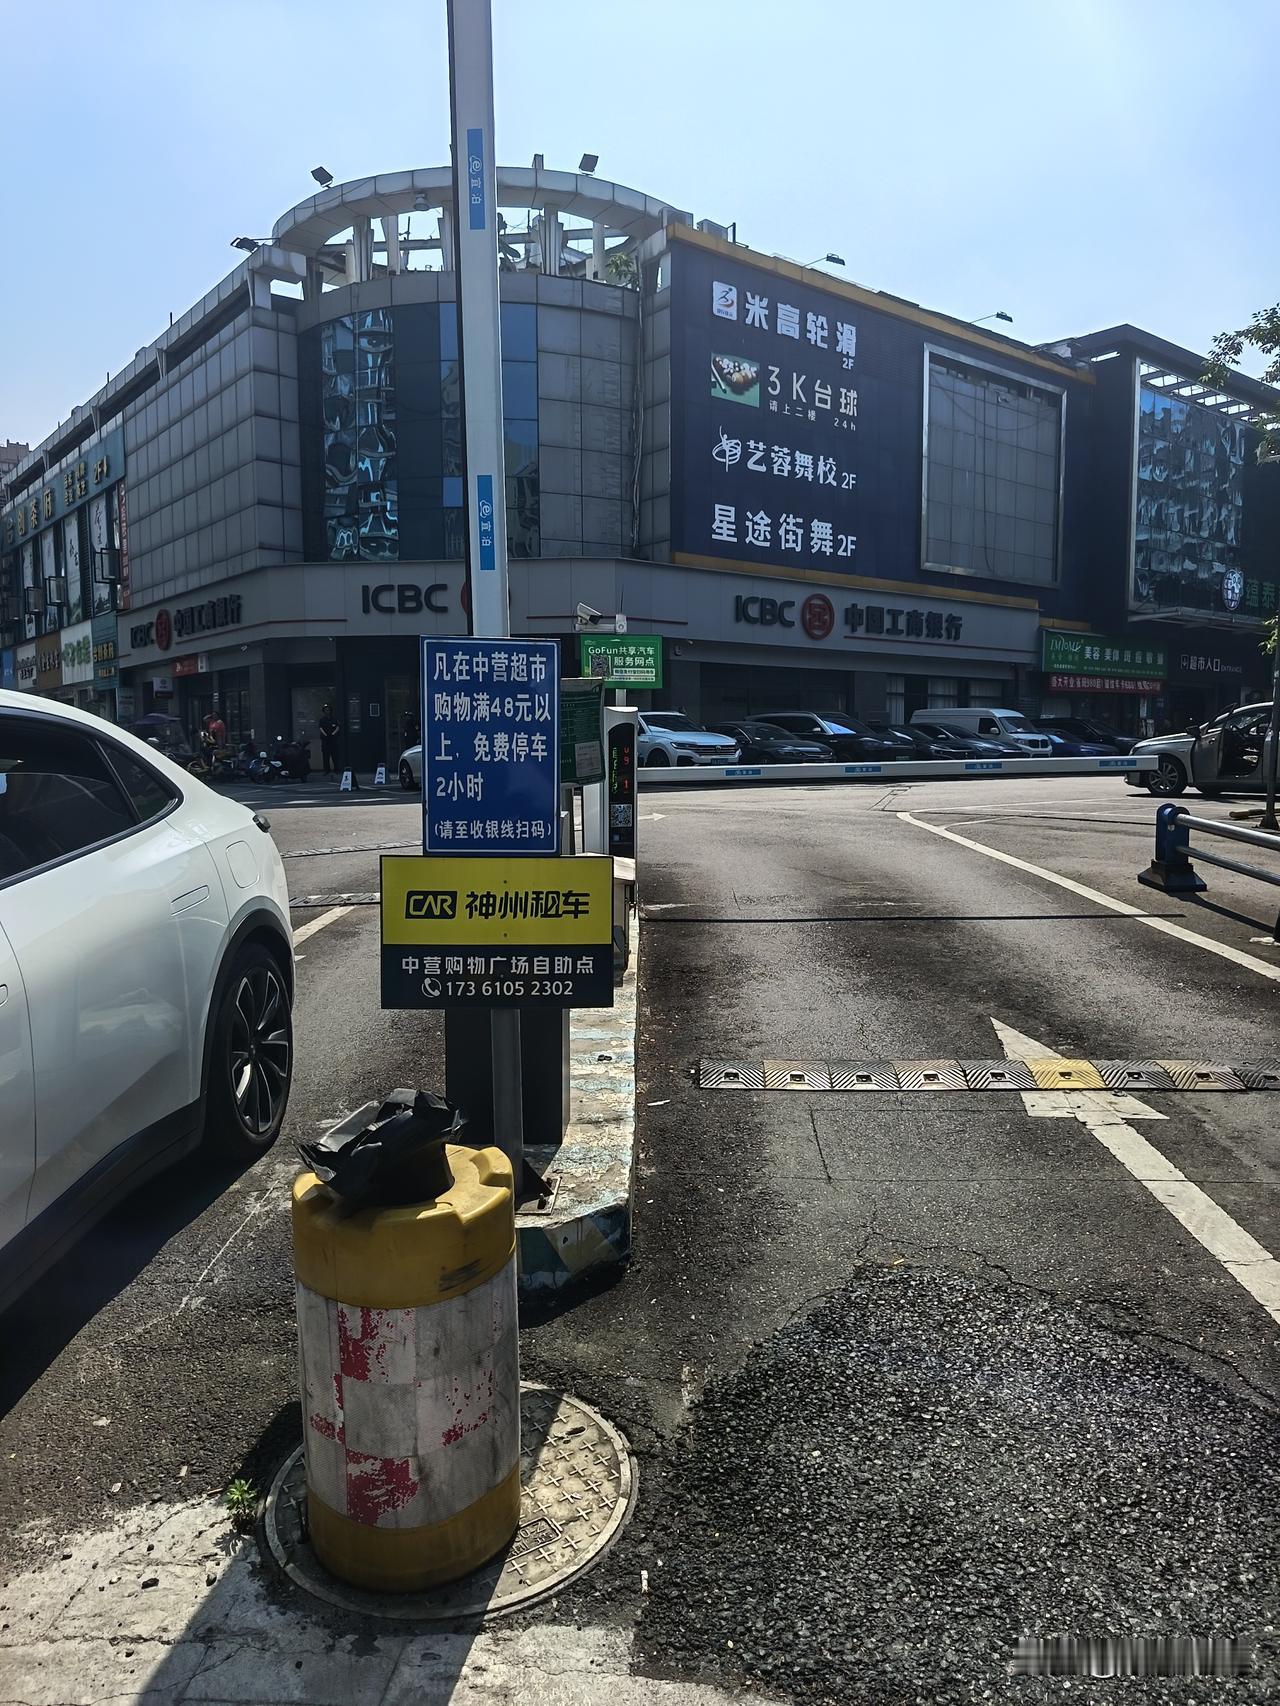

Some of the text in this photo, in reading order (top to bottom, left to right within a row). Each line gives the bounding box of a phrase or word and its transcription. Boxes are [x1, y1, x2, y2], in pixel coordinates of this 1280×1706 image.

[744, 290, 857, 359] 米高轮滑
[842, 357, 854, 370] 2F
[768, 399, 817, 422] 请上二楼
[833, 417, 856, 432] 24h
[745, 439, 857, 490] 艺蓉舞校 2F
[711, 503, 857, 558] 星途街舞 2F
[361, 583, 449, 614] ICBC
[174, 593, 243, 638] 中国工商银行
[735, 594, 963, 640] ICBC 中国工商银行
[433, 651, 548, 683] 凡在中营超市
[613, 656, 655, 668] 服务网点
[433, 692, 552, 723] 购物满48元以
[436, 771, 484, 803] 2小时
[407, 890, 591, 920] CAR 神州租车
[401, 955, 595, 976] 中营购物广场自助点
[446, 981, 574, 996] 173 6105 2302
